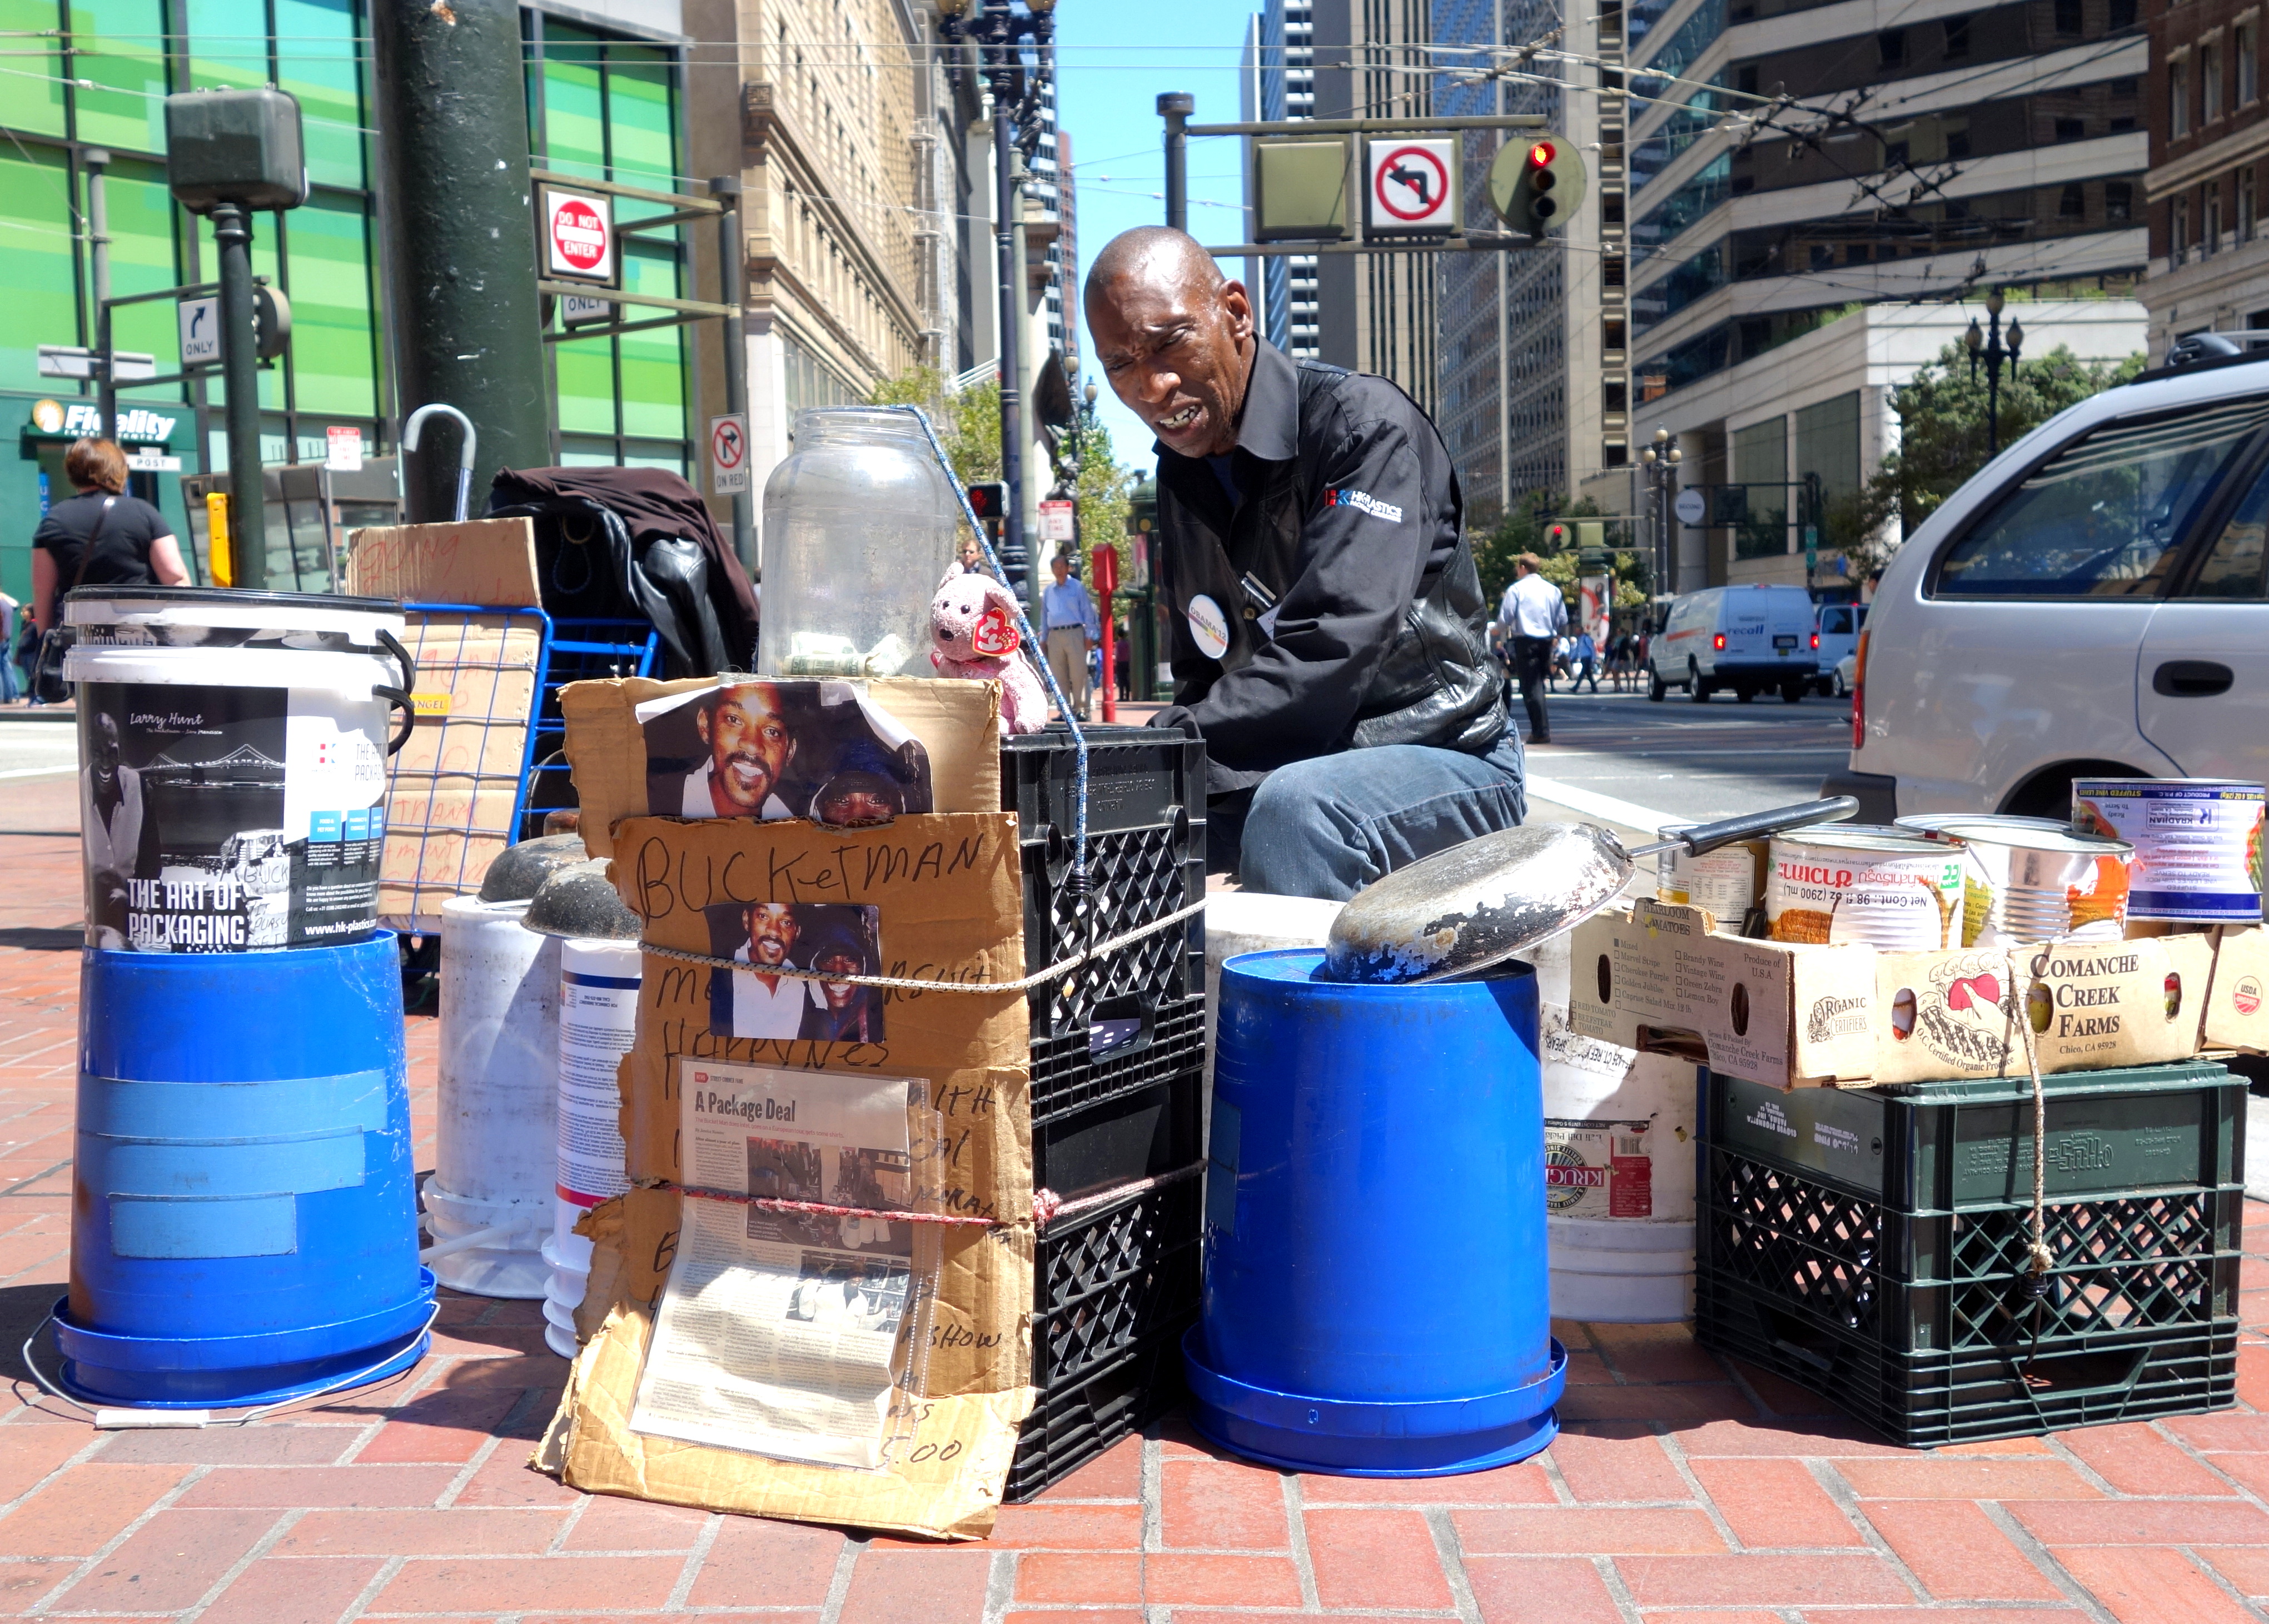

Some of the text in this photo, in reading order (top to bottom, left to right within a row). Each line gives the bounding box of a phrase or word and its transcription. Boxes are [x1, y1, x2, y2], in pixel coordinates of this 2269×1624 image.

[558, 211, 598, 230] DO NOT
[563, 241, 598, 258] ENTER
[186, 340, 213, 356] ONLY
[137, 459, 166, 467] POST
[716, 473, 743, 487] ON RED
[1190, 606, 1227, 640] OBAMA'12
[1727, 624, 1765, 635] recall
[130, 712, 204, 729] Larry Hunt
[357, 744, 370, 760] THE
[127, 877, 242, 910] THE ART OF
[1783, 883, 1799, 896] mL)
[1800, 888, 1827, 901] (2900
[1830, 891, 1843, 900] oz
[1857, 894, 1870, 905] 98
[1910, 896, 1927, 908] Net
[1643, 902, 1690, 920] HEIRLOOM
[128, 914, 245, 945] PACKAGING
[1643, 918, 1690, 936] OMATOES
[1620, 940, 1638, 951] Mixed
[1620, 950, 1661, 968] Marvel Stripe
[1683, 952, 1724, 968] Brandy Wine
[1744, 953, 1781, 968] Produce of
[2030, 954, 2139, 978] COMANCHE
[1621, 964, 1669, 983] Cherokee Purple
[1683, 964, 1725, 982] Vintage Wine
[1751, 967, 1774, 980] U.S.A.
[1621, 977, 1664, 994] Golden Jubilee
[1683, 978, 1723, 994] Green Zebra
[2241, 984, 2257, 996] USDA
[1621, 990, 1694, 1014] Caprise Salad Mix 12 lb.
[1683, 990, 1719, 1007] Lemon Boy
[2056, 983, 2121, 1008] CREEK
[1578, 1001, 1616, 1018] RED TOMATO
[1578, 1013, 1613, 1029] BEEFSTEAK
[1579, 1021, 1604, 1035] TOMATO
[1830, 1017, 1867, 1036] CERTIFIERS
[2057, 1014, 2121, 1038] FARMS
[1545, 1035, 1567, 1053] SPEARS
[1708, 1029, 1722, 1040] Grown
[1728, 1034, 1745, 1045] Packed
[1708, 1039, 1783, 1065] Comanche Creek Farms
[1917, 1028, 2014, 1073] O.C. Certified Organic Produce
[2059, 1040, 2117, 1055] Chico, CA 95928
[1709, 1049, 1758, 1071] Chico, CA 95928
[695, 1090, 796, 1123] A Package Deal
[772, 1125, 794, 1135] European
[1562, 1147, 1582, 1164] QUALITY
[1563, 1193, 1579, 1207] FAMILY
